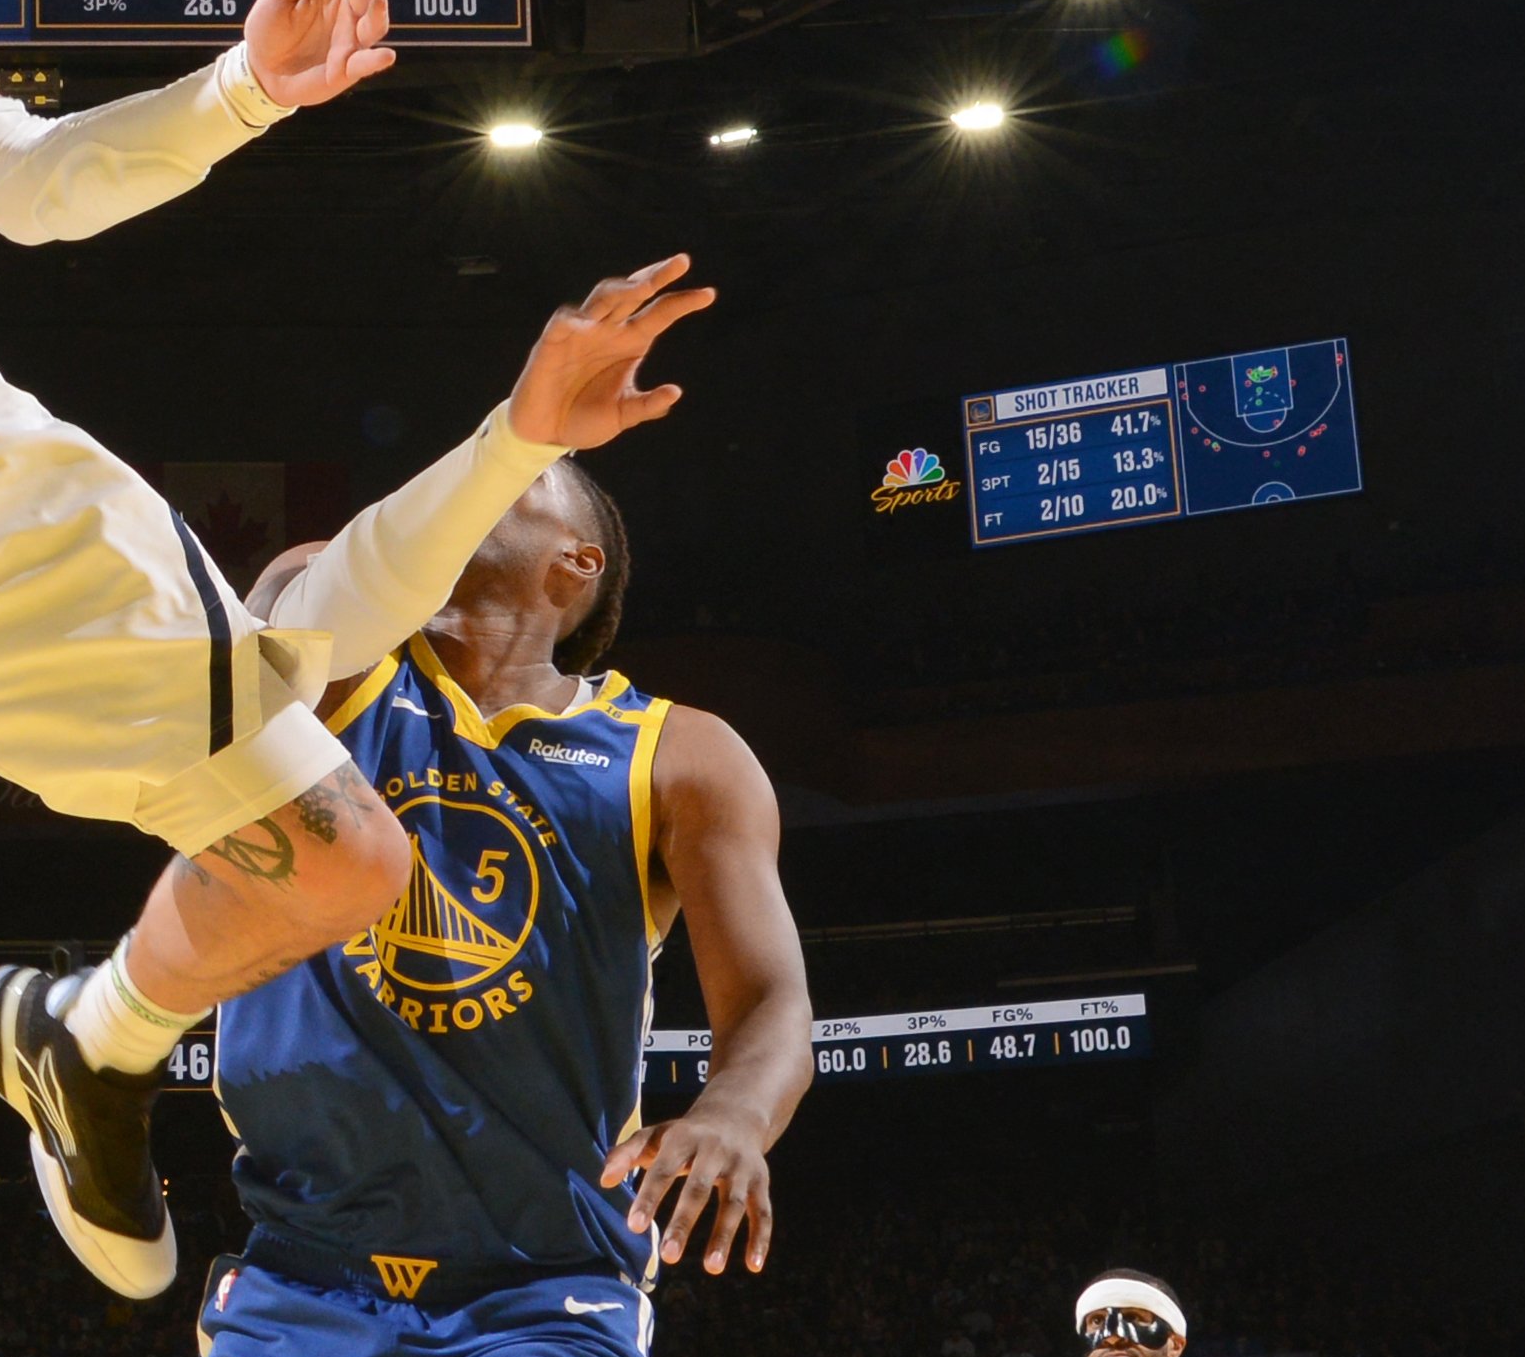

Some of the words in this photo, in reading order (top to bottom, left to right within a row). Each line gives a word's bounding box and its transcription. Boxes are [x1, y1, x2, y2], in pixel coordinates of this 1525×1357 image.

[1014, 390, 1056, 413] SHOT
[1061, 377, 1139, 407] TRACKER
[979, 441, 1001, 455] FG
[1025, 422, 1082, 451] 15/36
[982, 476, 1010, 490] 3PT
[1038, 460, 1081, 485] 2/15
[871, 477, 962, 514] Sports
[984, 513, 1003, 527] FT
[1041, 496, 1084, 521] 2/10
[529, 739, 610, 768] Rakuten
[488, 780, 556, 847] STATE
[471, 850, 509, 903] 5
[822, 1022, 861, 1037] 2P%
[907, 1015, 947, 1030] 3P%
[992, 1008, 1033, 1023] FG%
[1080, 1001, 1119, 1016] FT%
[818, 1046, 866, 1074] 60.0
[904, 1040, 951, 1067] 28.6
[989, 1034, 1036, 1060] 48.7
[1070, 1026, 1131, 1054] 100.0
